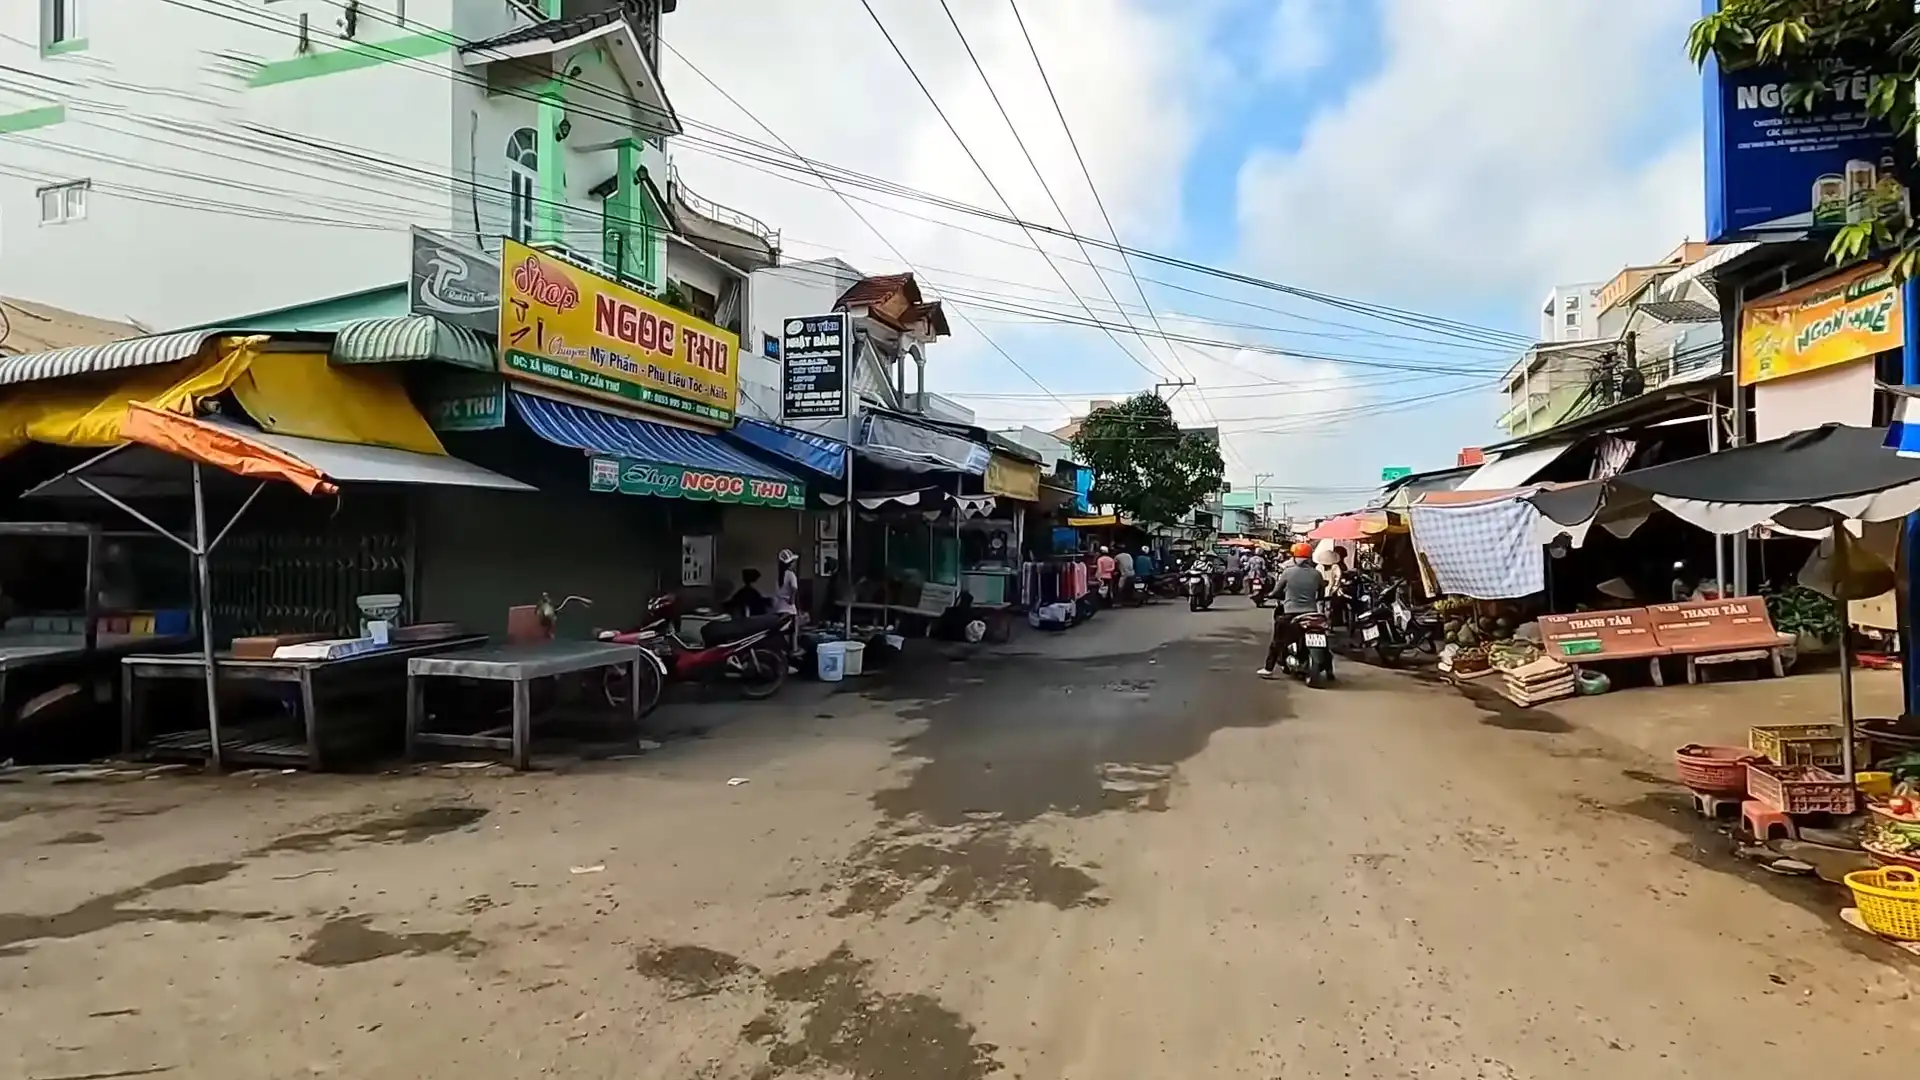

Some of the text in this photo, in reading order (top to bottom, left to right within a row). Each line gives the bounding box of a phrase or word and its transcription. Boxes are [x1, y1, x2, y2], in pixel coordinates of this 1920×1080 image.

[514, 254, 580, 315] Shop
[595, 292, 675, 356] NGỌC
[1797, 308, 1846, 354] NGON
[588, 346, 606, 367] Mỹ
[609, 352, 638, 374] Phẩm
[647, 364, 665, 385] Phụ
[688, 376, 703, 393] Tóc
[710, 383, 728, 401] Nails
[681, 471, 745, 497] NGỌC
[749, 480, 788, 499] THU
[1568, 615, 1633, 630] THANH TÂM
[1681, 603, 1749, 619] THANH TÂM
